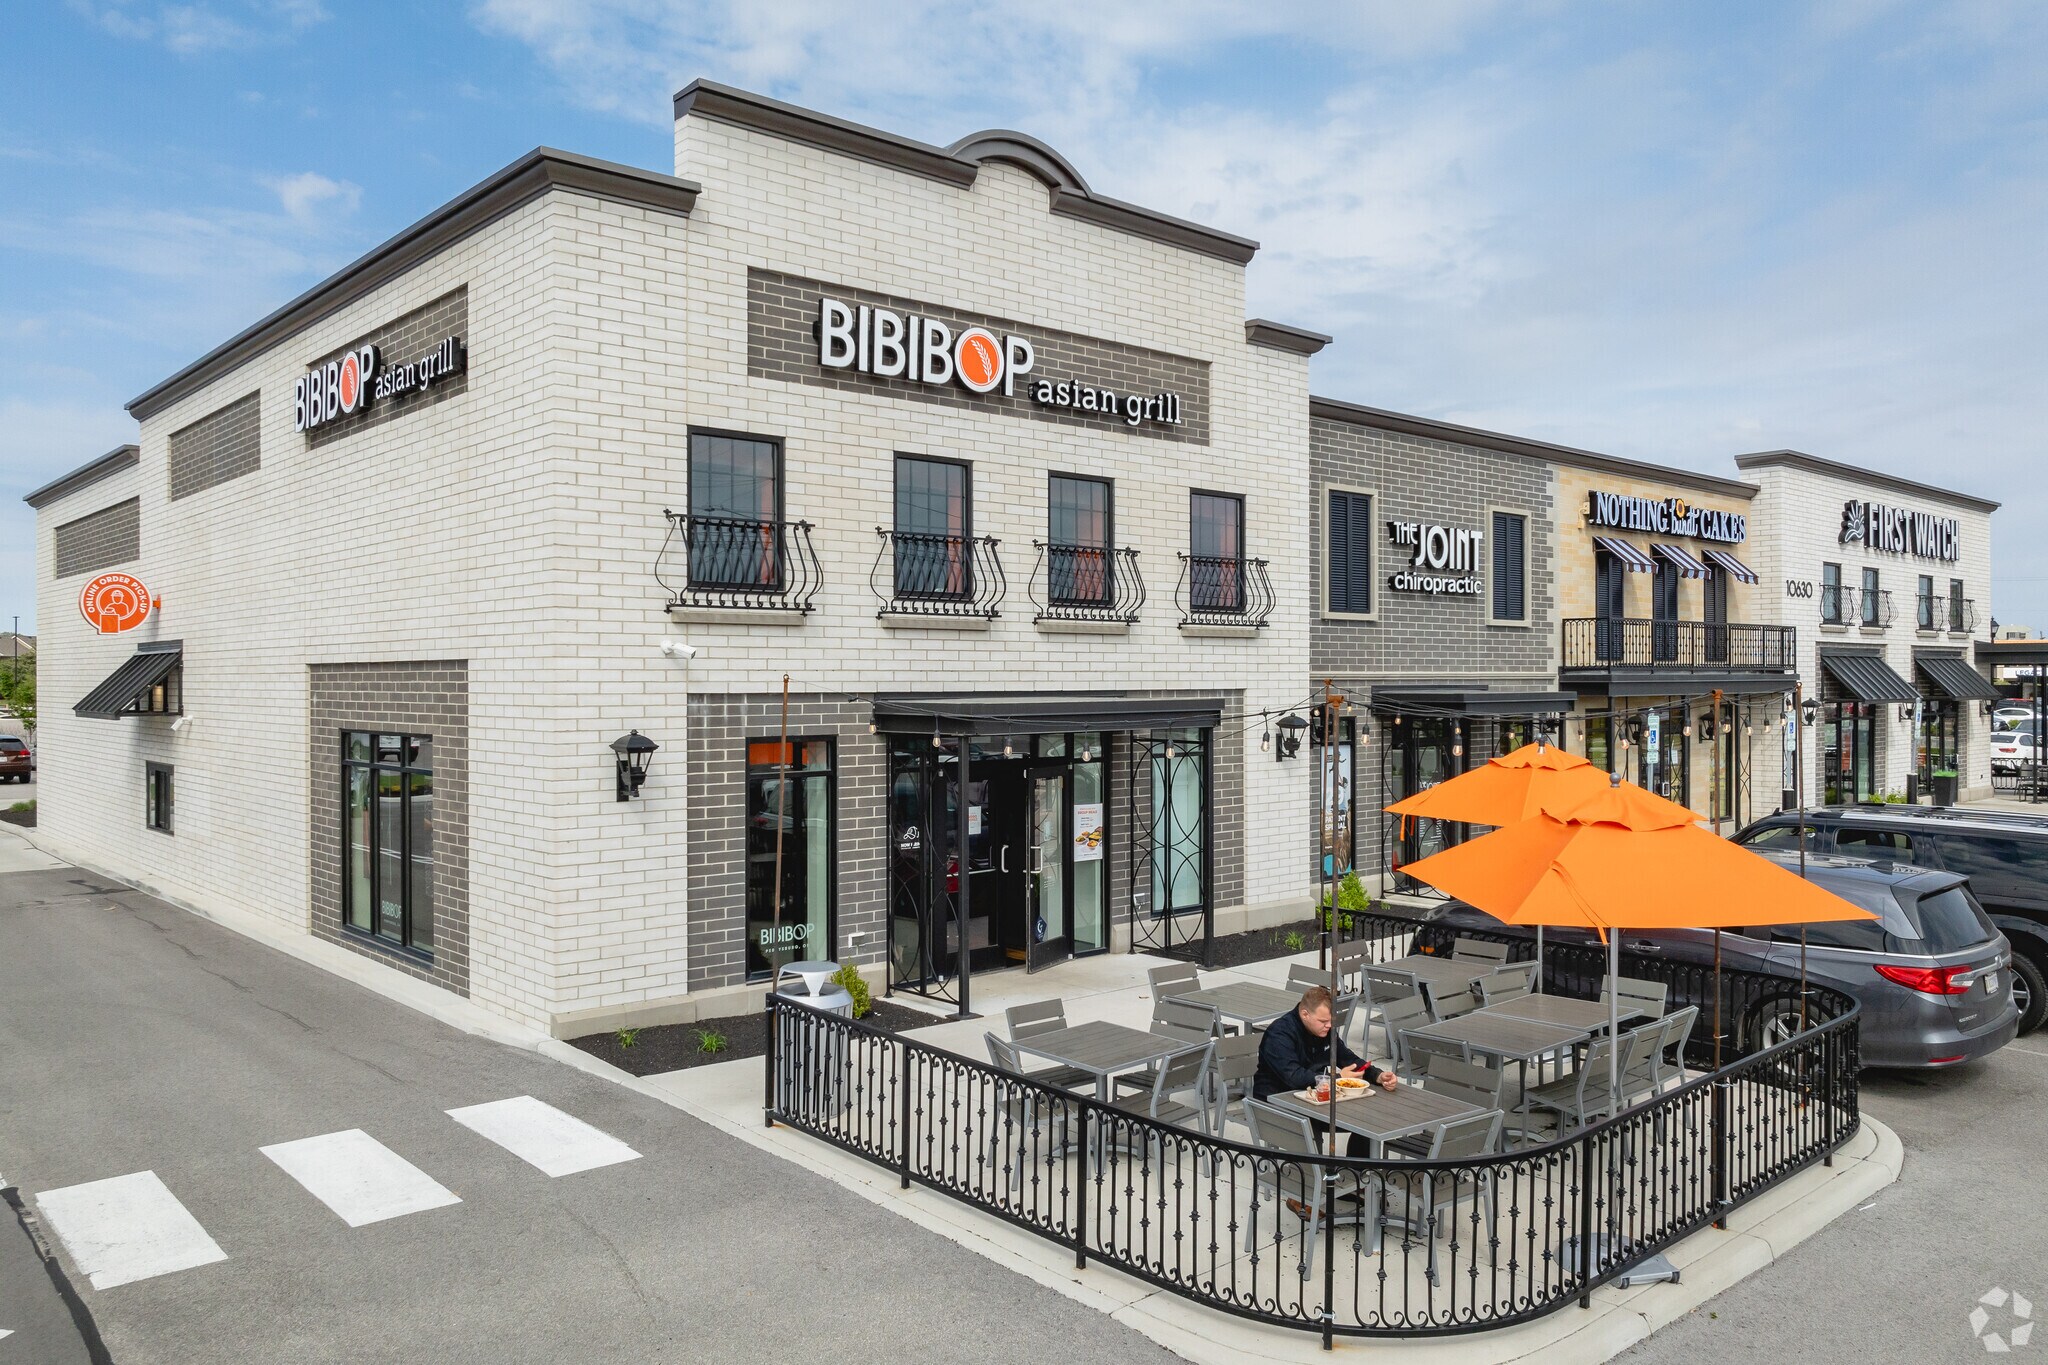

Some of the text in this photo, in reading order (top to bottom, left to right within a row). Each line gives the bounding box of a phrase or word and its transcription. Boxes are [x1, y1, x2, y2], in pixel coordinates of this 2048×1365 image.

[821, 297, 1182, 427] BIBIBOP asian grill
[295, 336, 454, 433] BIBIBOP asian grill
[1596, 490, 1668, 533] NOTHING
[1700, 508, 1747, 544] CAKES
[1868, 502, 1960, 561] FIRST WATCH
[1393, 521, 1483, 571] THE JOINT
[85, 575, 148, 614] ONLINE ORDER PICK-UP
[1394, 571, 1482, 595] chiropractic
[1785, 579, 1813, 599] 10630
[1325, 814, 1346, 824] PATNT
[1325, 822, 1347, 831] SPIAL
